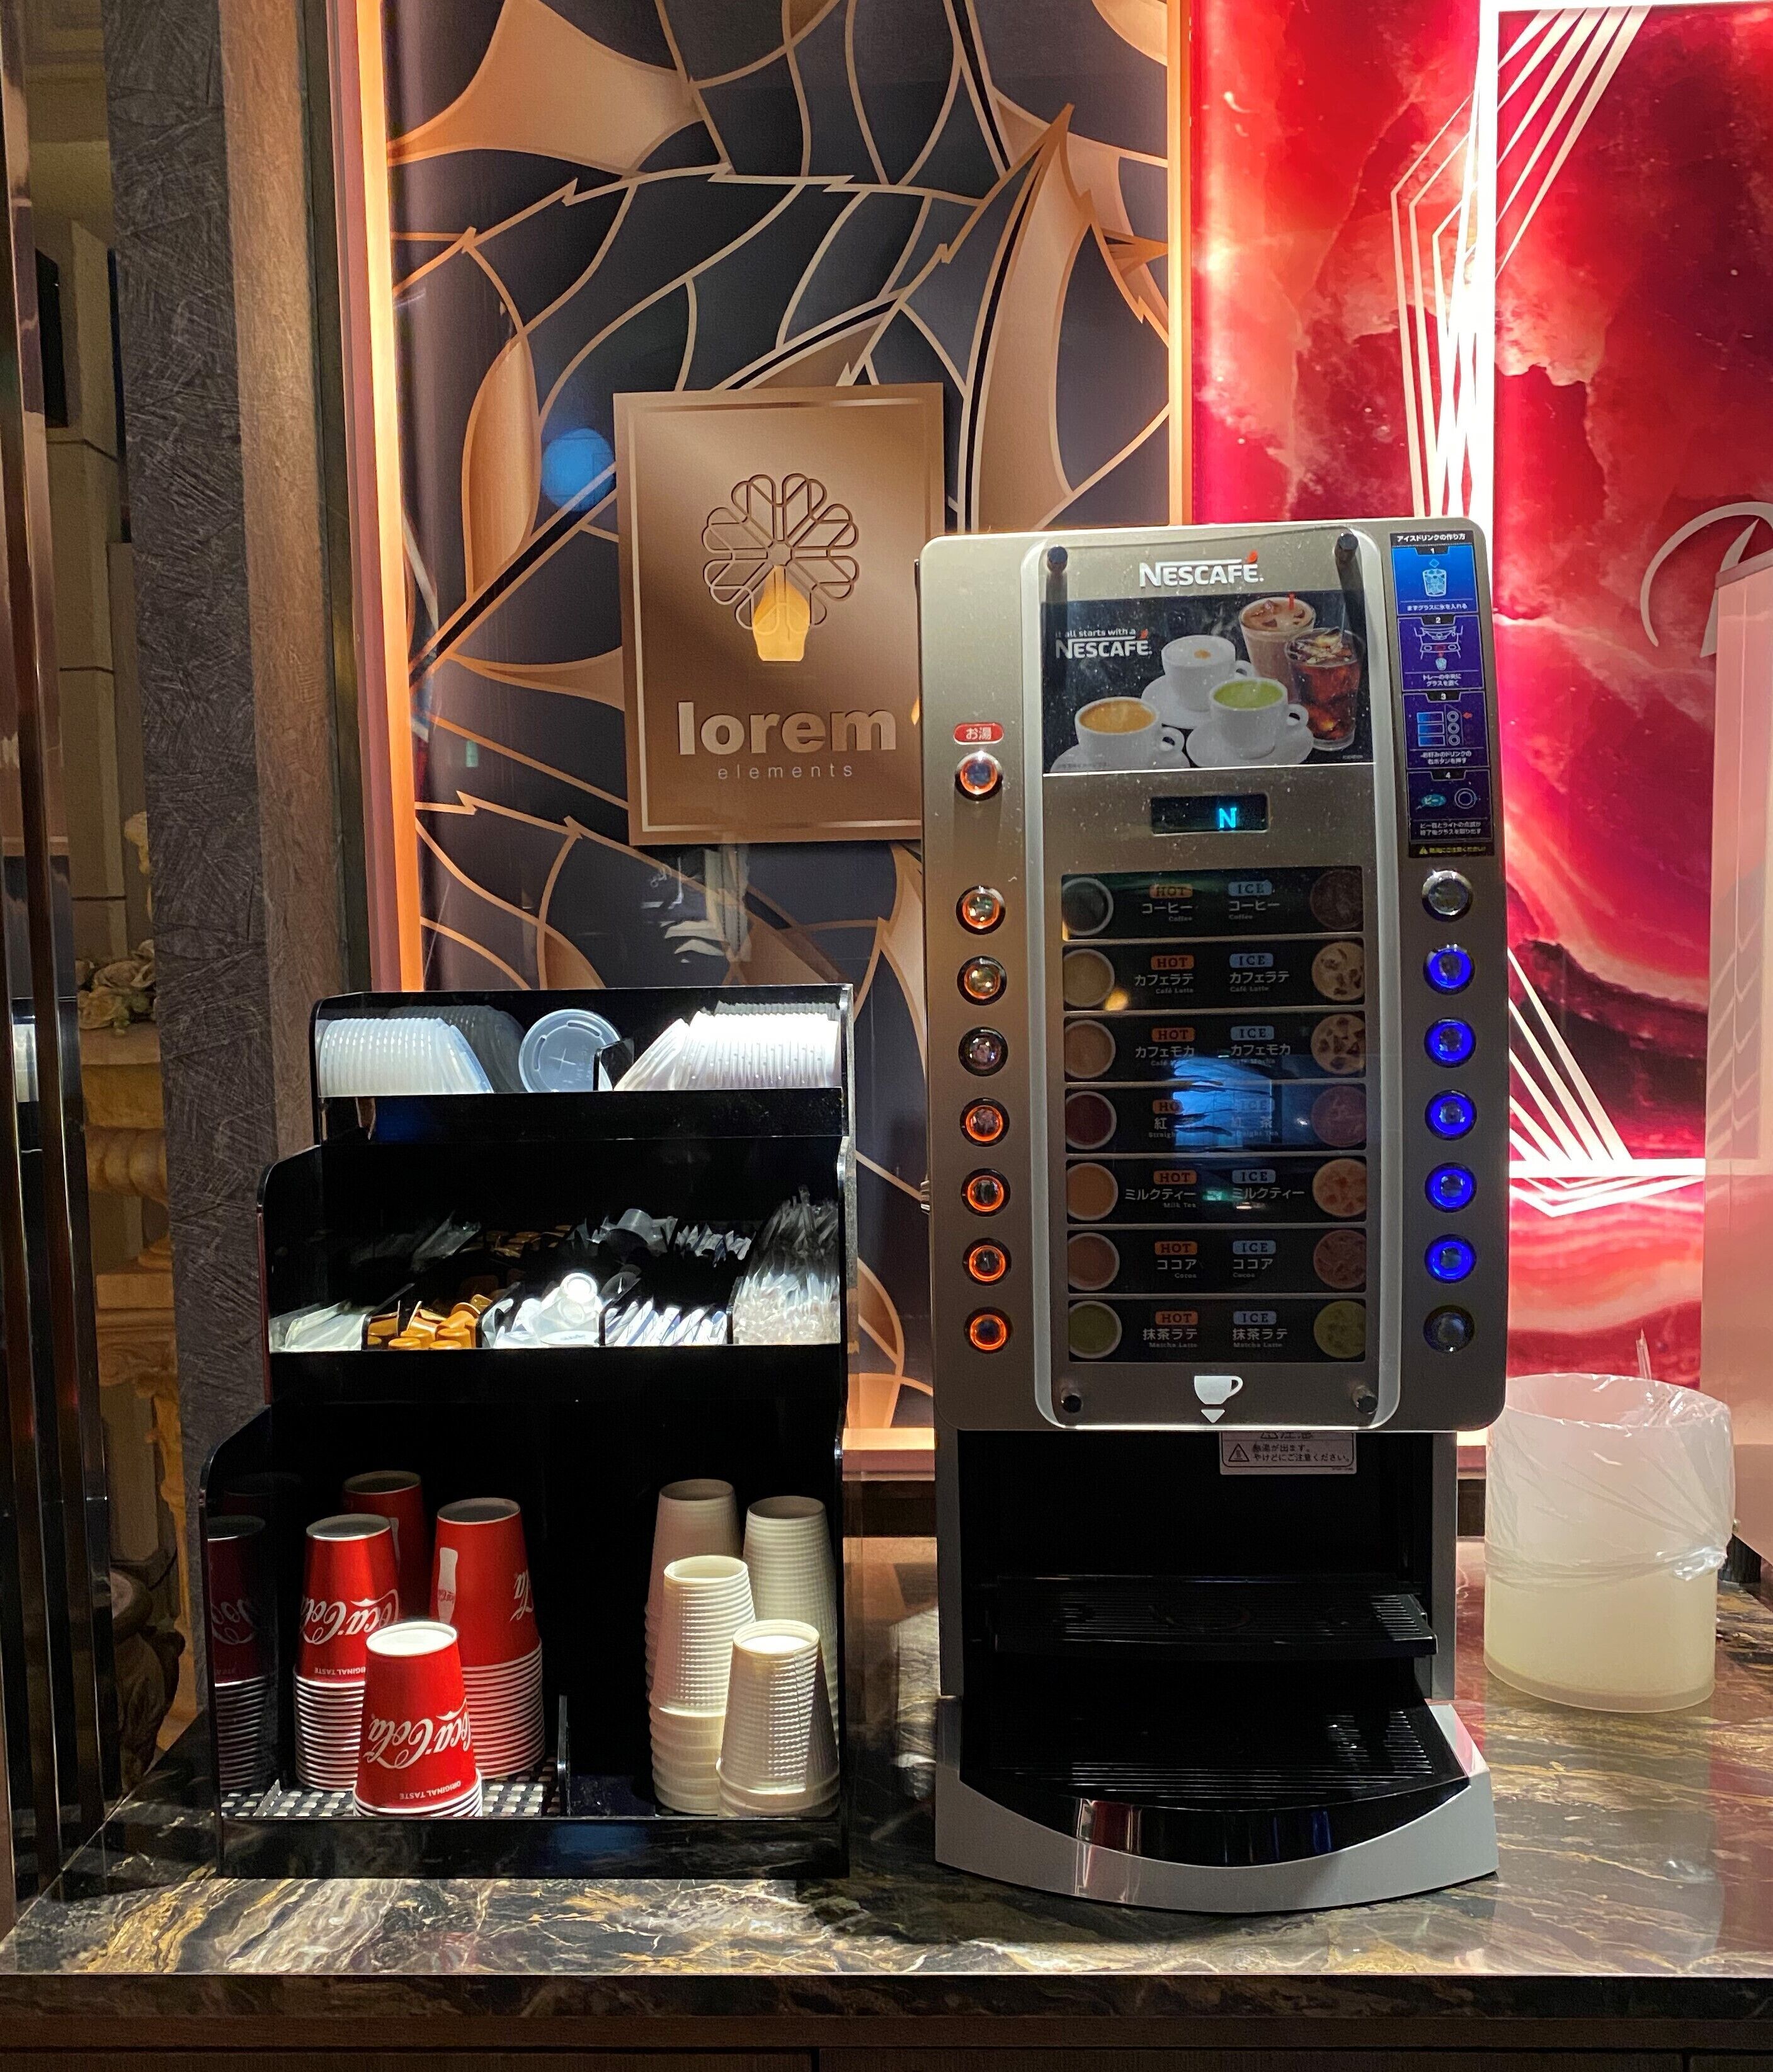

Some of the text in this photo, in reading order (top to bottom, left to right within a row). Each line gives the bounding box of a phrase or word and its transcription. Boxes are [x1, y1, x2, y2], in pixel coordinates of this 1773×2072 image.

[1079, 629, 1105, 637] starts
[1107, 627, 1127, 636] with
[677, 701, 897, 755] lorem
[966, 726, 992, 740] お湯
[717, 763, 853, 780] elements
[1219, 808, 1237, 828] N
[1156, 886, 1185, 896] HOT
[1238, 884, 1265, 894] ICE
[1142, 902, 1193, 913] コーヒー
[1229, 900, 1280, 911] コーヒー
[1157, 958, 1189, 968] HOT
[1239, 956, 1265, 965] ICE
[1134, 973, 1194, 987] カフェラテ
[1229, 971, 1290, 984] カフェラテ
[1158, 1029, 1189, 1040] HOT
[1240, 1028, 1267, 1038] ICE
[1135, 1045, 1194, 1058] カフェモカ
[1231, 1043, 1291, 1056] カフェモカ
[1160, 1172, 1191, 1182] HOT
[1241, 1172, 1268, 1182] ICE
[1125, 1188, 1196, 1200] ミルクティー
[1232, 1188, 1305, 1199] ミルクティー
[1161, 1244, 1190, 1253] HOT
[1242, 1243, 1268, 1252] ICE
[1157, 1259, 1197, 1270] ココア
[1233, 1258, 1274, 1269] ココア
[1161, 1313, 1192, 1323] HOT
[1243, 1313, 1268, 1322] ICE
[1143, 1328, 1197, 1341] 抹茶ラテ
[1233, 1328, 1287, 1341] 抹茶ラテ
[315, 1667, 336, 1675] TASTE
[399, 1780, 461, 1800] ORIGINAL TASTE
